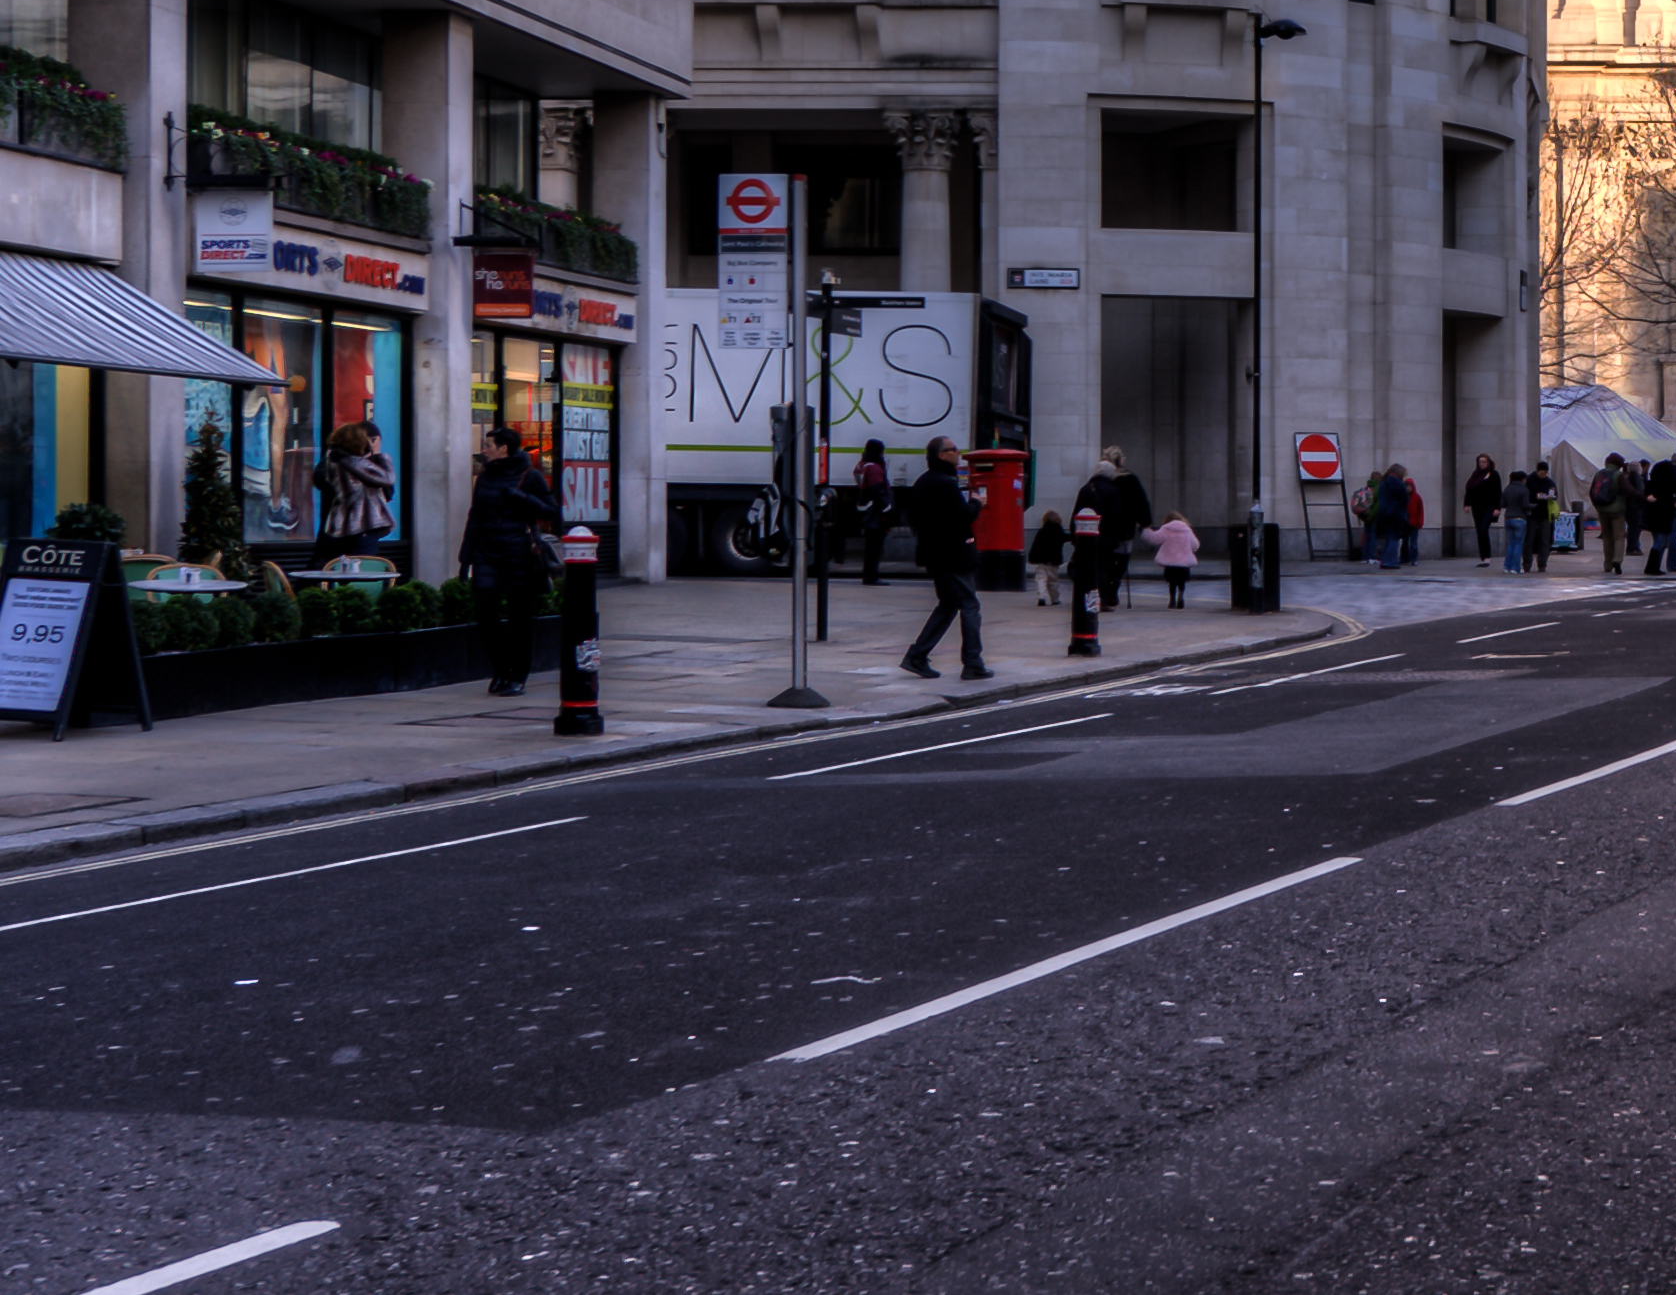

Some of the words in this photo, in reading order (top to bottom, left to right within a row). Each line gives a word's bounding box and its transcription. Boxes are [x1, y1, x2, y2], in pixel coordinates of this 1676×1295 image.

[201, 239, 250, 250] SPORTS
[273, 240, 319, 276] ORTS
[562, 466, 610, 521] SALE
[22, 544, 86, 566] CÔTE
[18, 565, 82, 575] BRASSERIE
